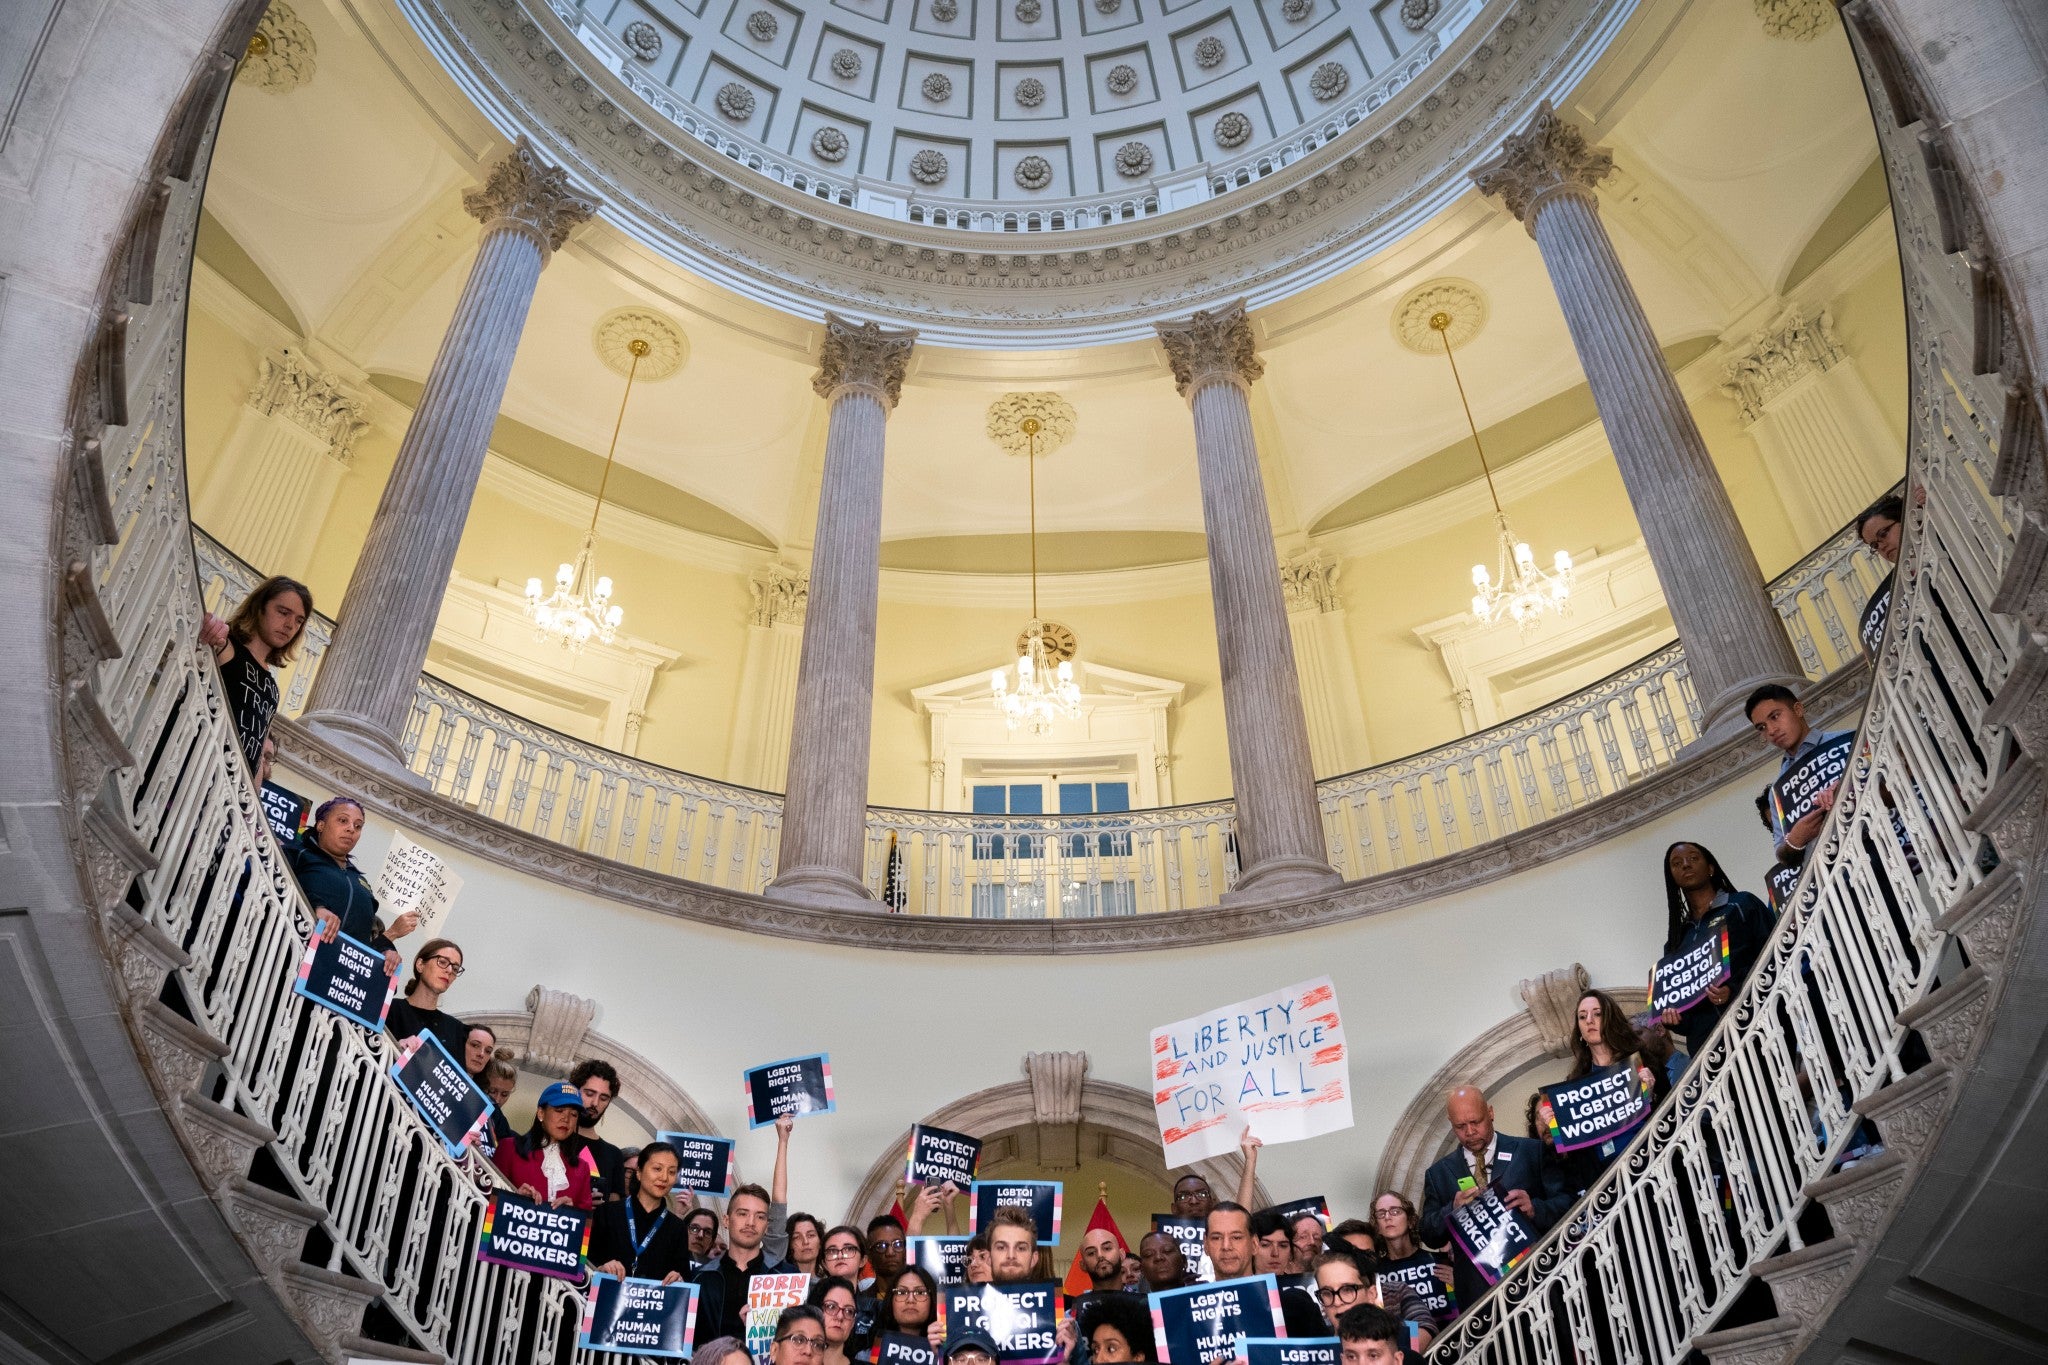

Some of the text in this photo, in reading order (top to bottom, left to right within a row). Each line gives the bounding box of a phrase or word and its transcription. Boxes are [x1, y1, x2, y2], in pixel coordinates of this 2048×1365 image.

[1862, 590, 1891, 644] PROTE
[241, 710, 266, 740] LIV
[1782, 741, 1852, 796] PROTECT
[1791, 758, 1846, 804] LGBTQI
[260, 787, 298, 812] TECT
[261, 801, 288, 822] TQI
[408, 857, 424, 866] NOT
[410, 846, 445, 872] SCOTUS
[387, 851, 447, 903] DISCRIMINATION
[393, 898, 409, 907] AT
[338, 954, 372, 978] RIGHTS
[341, 943, 374, 968] LGBTQI
[1655, 935, 1717, 982] PROTECT
[1662, 955, 1713, 992] LGBTQI
[331, 975, 367, 1001] HUMAN
[1653, 962, 1722, 1011] WORKERS
[327, 987, 363, 1011] RIGHTS
[1172, 1000, 1294, 1059] LIBERTY
[1182, 1025, 1325, 1077] AND JUSTICE
[438, 1059, 470, 1095] LGBTQI
[767, 1064, 801, 1078] LGBTQI
[768, 1073, 803, 1088] RIGHTS
[432, 1066, 464, 1102] RIGHTS
[1174, 1062, 1316, 1125] FOR ALL
[1556, 1068, 1632, 1107] PROTECT
[415, 1088, 446, 1125] RIGHTS
[420, 1080, 452, 1117] HUMAN
[770, 1091, 805, 1106] HUMAN
[772, 1102, 803, 1116] RIGHT
[1570, 1087, 1631, 1120] LGBTQI
[1561, 1097, 1643, 1139] WORKERS
[683, 1150, 713, 1160] RIGHTS
[684, 1140, 714, 1152] LGBTQI
[921, 1134, 975, 1158] PROTECT
[926, 1149, 969, 1170] LGBTQI
[680, 1177, 710, 1188] RIGHTS
[681, 1168, 711, 1178] HUMAN
[915, 1161, 973, 1186] WORKERS
[996, 1197, 1033, 1207] RIGHTS
[997, 1188, 1033, 1197] LGBTQI
[502, 1202, 580, 1232] PROTECT
[1483, 1187, 1528, 1243] ROTECT
[507, 1221, 569, 1248] LGBTQI
[1163, 1225, 1206, 1240] PROT
[492, 1235, 578, 1268] WORKERS
[938, 1244, 967, 1253] LGBT
[939, 1255, 965, 1264] RIGH
[752, 1275, 807, 1291] BORN
[938, 1276, 961, 1285] HUM
[1379, 1263, 1436, 1283] OTECT
[623, 1286, 665, 1299] LGBTQI
[749, 1289, 802, 1308] THIS
[953, 1291, 1048, 1313] PRECT
[1190, 1290, 1239, 1308] LGBTQI
[622, 1298, 664, 1311] RIGHTS
[1192, 1304, 1242, 1322] RIGHTS
[616, 1321, 661, 1334] HUMAN
[752, 1309, 780, 1325] WA
[615, 1332, 659, 1345] RIGHTS
[998, 1331, 1054, 1351] KERS
[886, 1342, 935, 1365] PROT
[1200, 1347, 1236, 1364] RIGHT
[1280, 1349, 1334, 1362] LGBTQI
